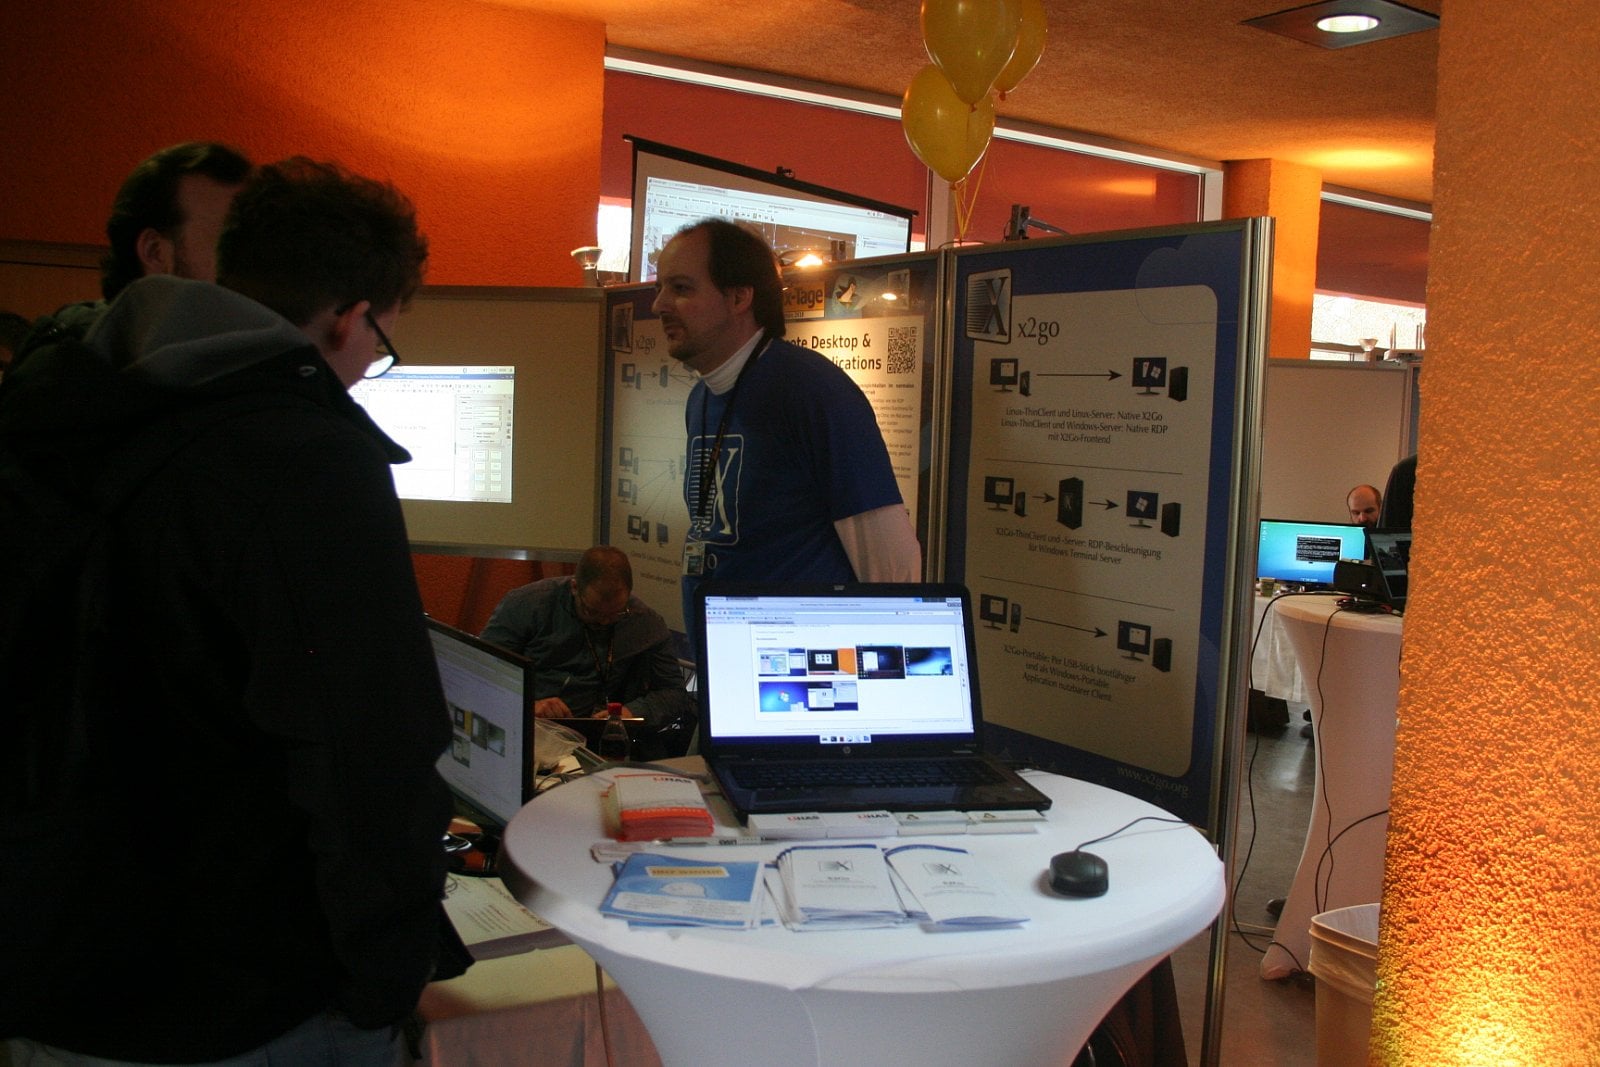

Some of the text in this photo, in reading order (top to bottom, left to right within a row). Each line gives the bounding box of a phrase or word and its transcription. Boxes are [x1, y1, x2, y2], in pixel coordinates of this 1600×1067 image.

[1017, 316, 1060, 346] x2go
[811, 334, 858, 351] Desktop
[862, 333, 871, 348] &
[1006, 407, 1056, 418] Linux-ThinClient
[1057, 409, 1071, 418] und
[1118, 411, 1141, 420] Native
[1142, 411, 1163, 421] X2Go
[1001, 419, 1051, 430] Linux-ThinClient
[1052, 420, 1065, 429] und
[1126, 424, 1150, 433] Native
[1151, 424, 1168, 434] RDP
[1048, 433, 1111, 444] mit X2Go-Frontend
[995, 527, 1046, 542] X2Go-ThinClient
[1047, 535, 1061, 544] und
[1088, 538, 1162, 560] RDP-Beschleunigung
[1039, 544, 1069, 557] Windows
[1070, 548, 1098, 561] Terminal
[1099, 554, 1122, 565] Server
[1025, 662, 1039, 672] und
